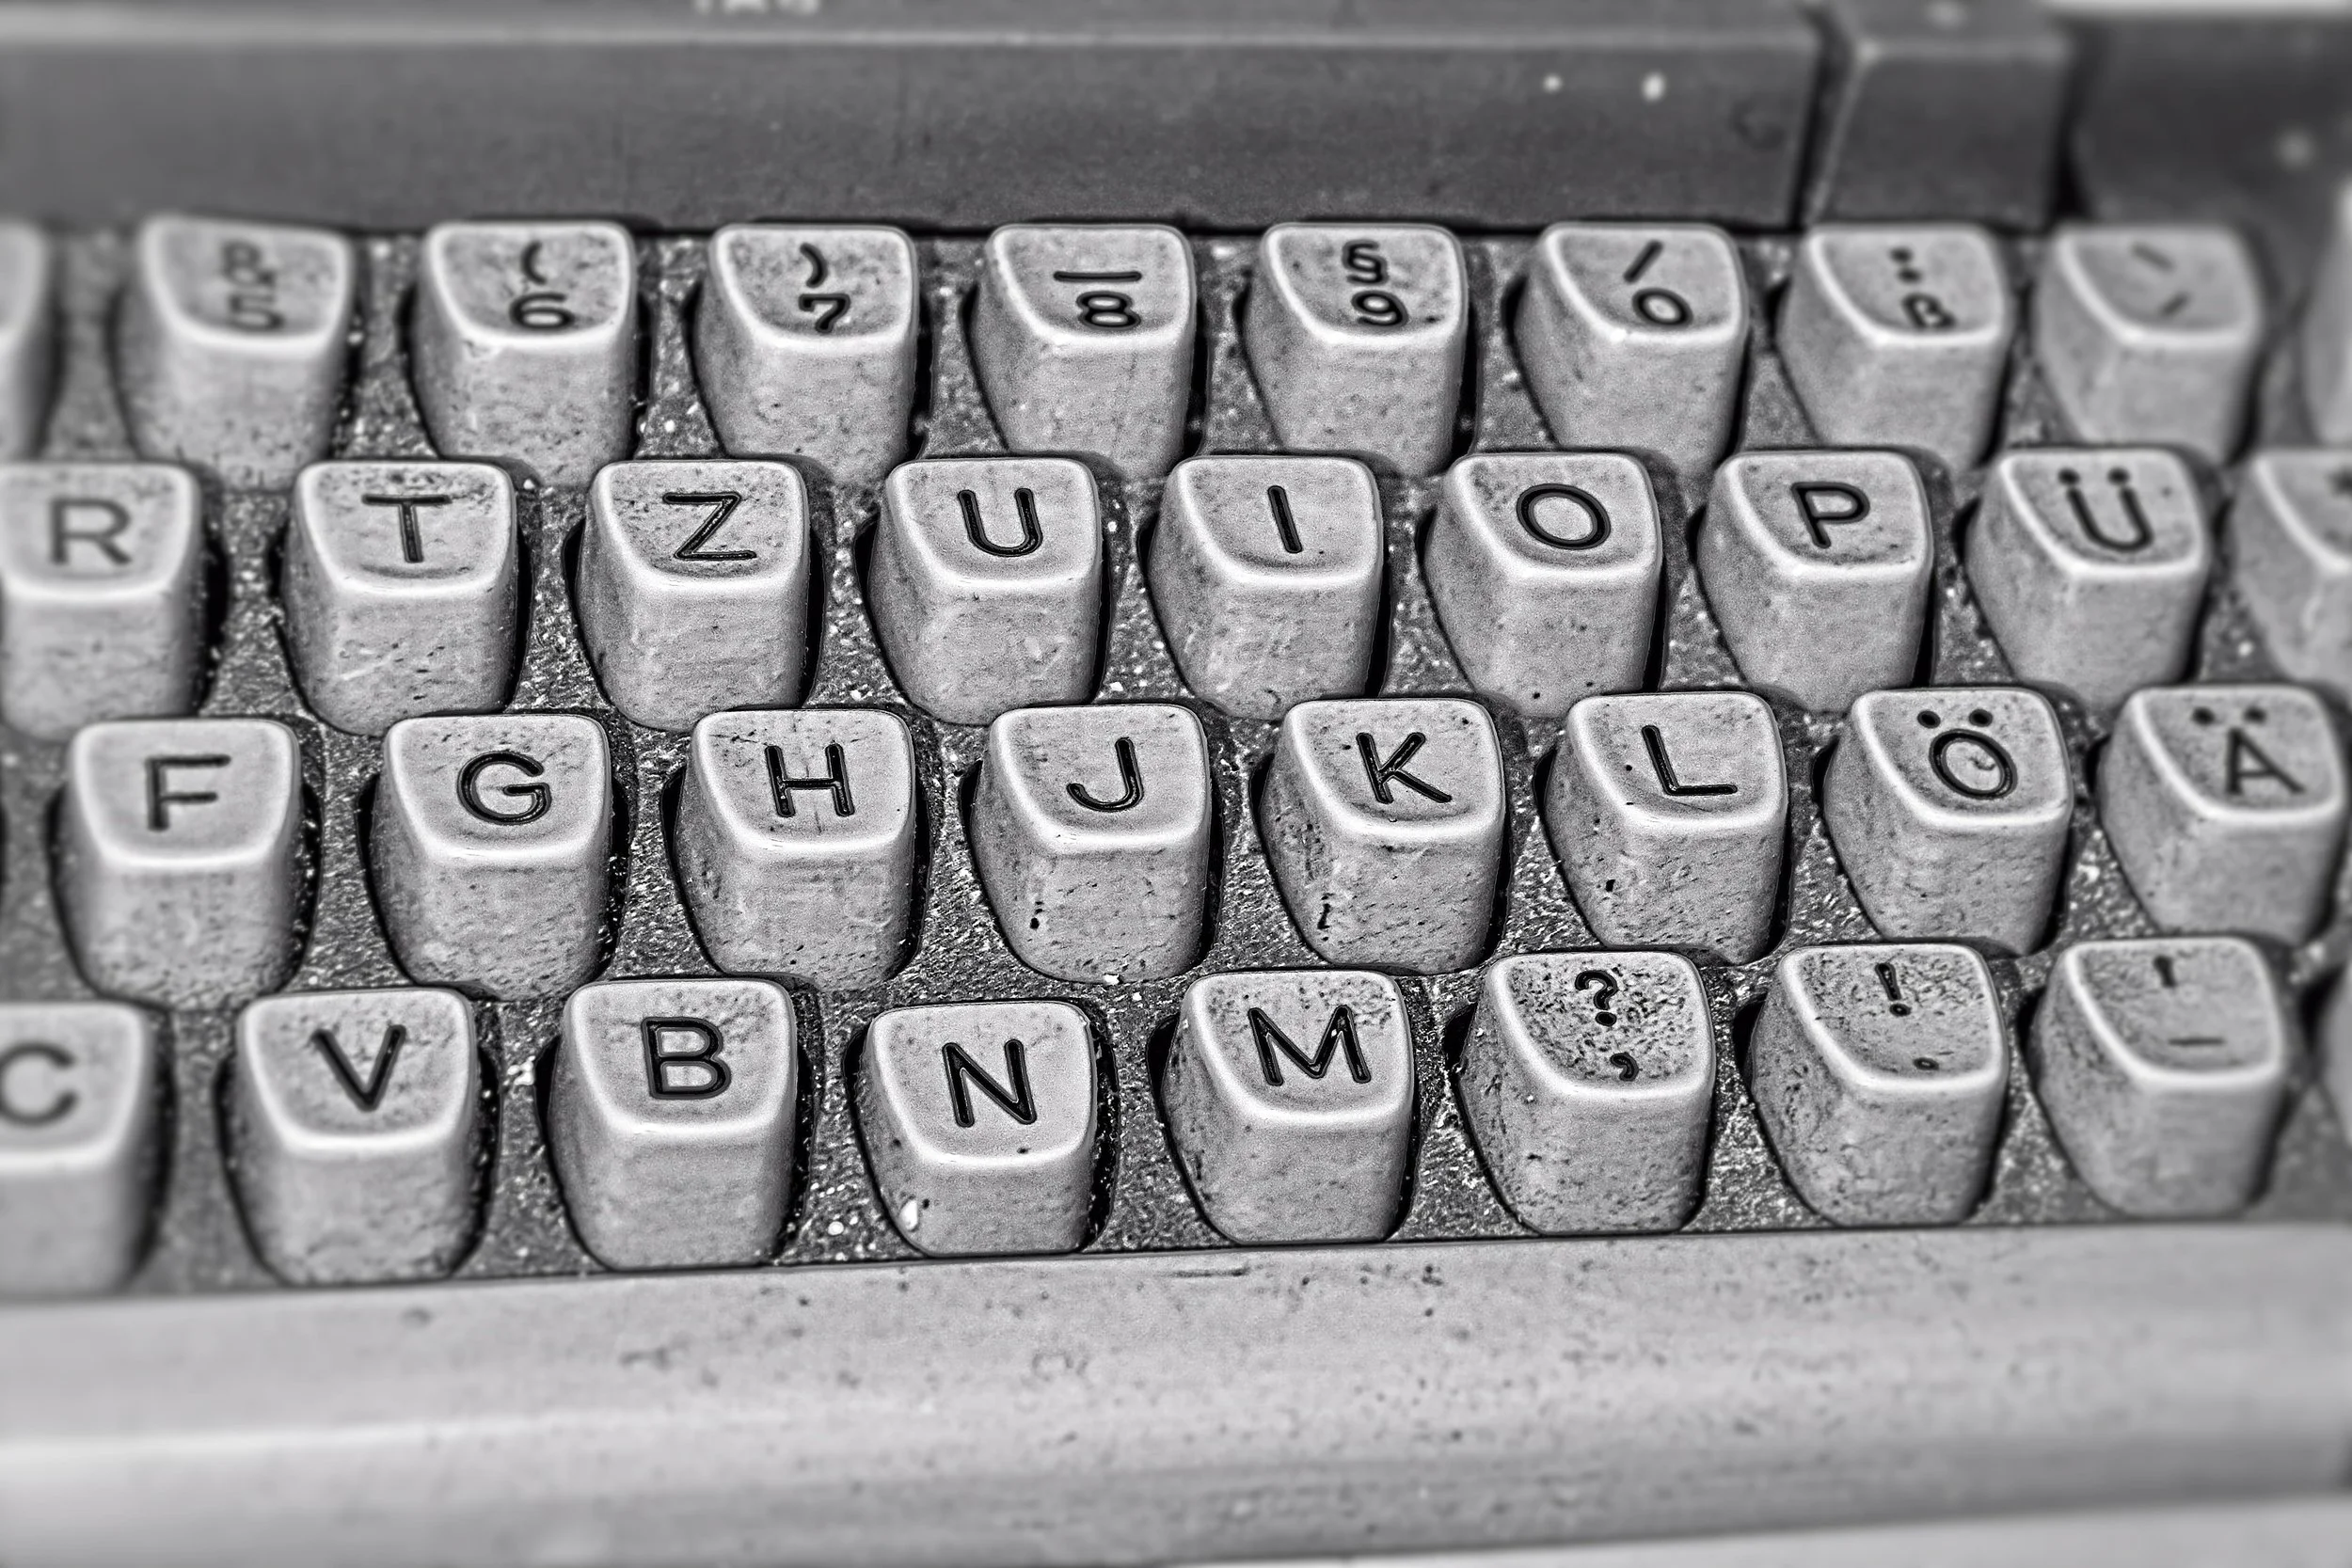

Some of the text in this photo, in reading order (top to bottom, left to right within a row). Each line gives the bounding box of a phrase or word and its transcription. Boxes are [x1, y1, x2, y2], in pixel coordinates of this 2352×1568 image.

[520, 240, 547, 283] (
[800, 244, 826, 287] )
[1342, 239, 1388, 286] §
[1623, 239, 1663, 283] /
[229, 293, 284, 331] 5
[509, 293, 572, 327] 6
[799, 293, 850, 332] 7
[1076, 291, 1140, 328] 8
[1351, 290, 1409, 331] 9
[49, 498, 130, 564] R
[361, 494, 451, 562] T
[662, 491, 756, 561] Z
[958, 487, 1043, 557] U
[1267, 485, 1303, 554] I
[1517, 483, 1611, 551] O
[1791, 481, 1870, 547] P
[2058, 467, 2153, 553] Ü
[767, 744, 854, 817] H
[1067, 736, 1144, 812] J
[1356, 732, 1452, 803] K
[1642, 725, 1737, 797] L
[1917, 710, 2017, 800] Ö
[2193, 705, 2305, 796] Ä
[145, 754, 230, 831] F
[457, 752, 551, 825] G
[1575, 970, 1618, 1027] ?
[1875, 962, 1911, 1017] !
[312, 1024, 407, 1111] V
[642, 1017, 731, 1100] B
[1248, 1006, 1371, 1086] M
[1610, 1053, 1638, 1082] ,
[0, 1042, 79, 1127] C
[942, 1039, 1037, 1128] N
